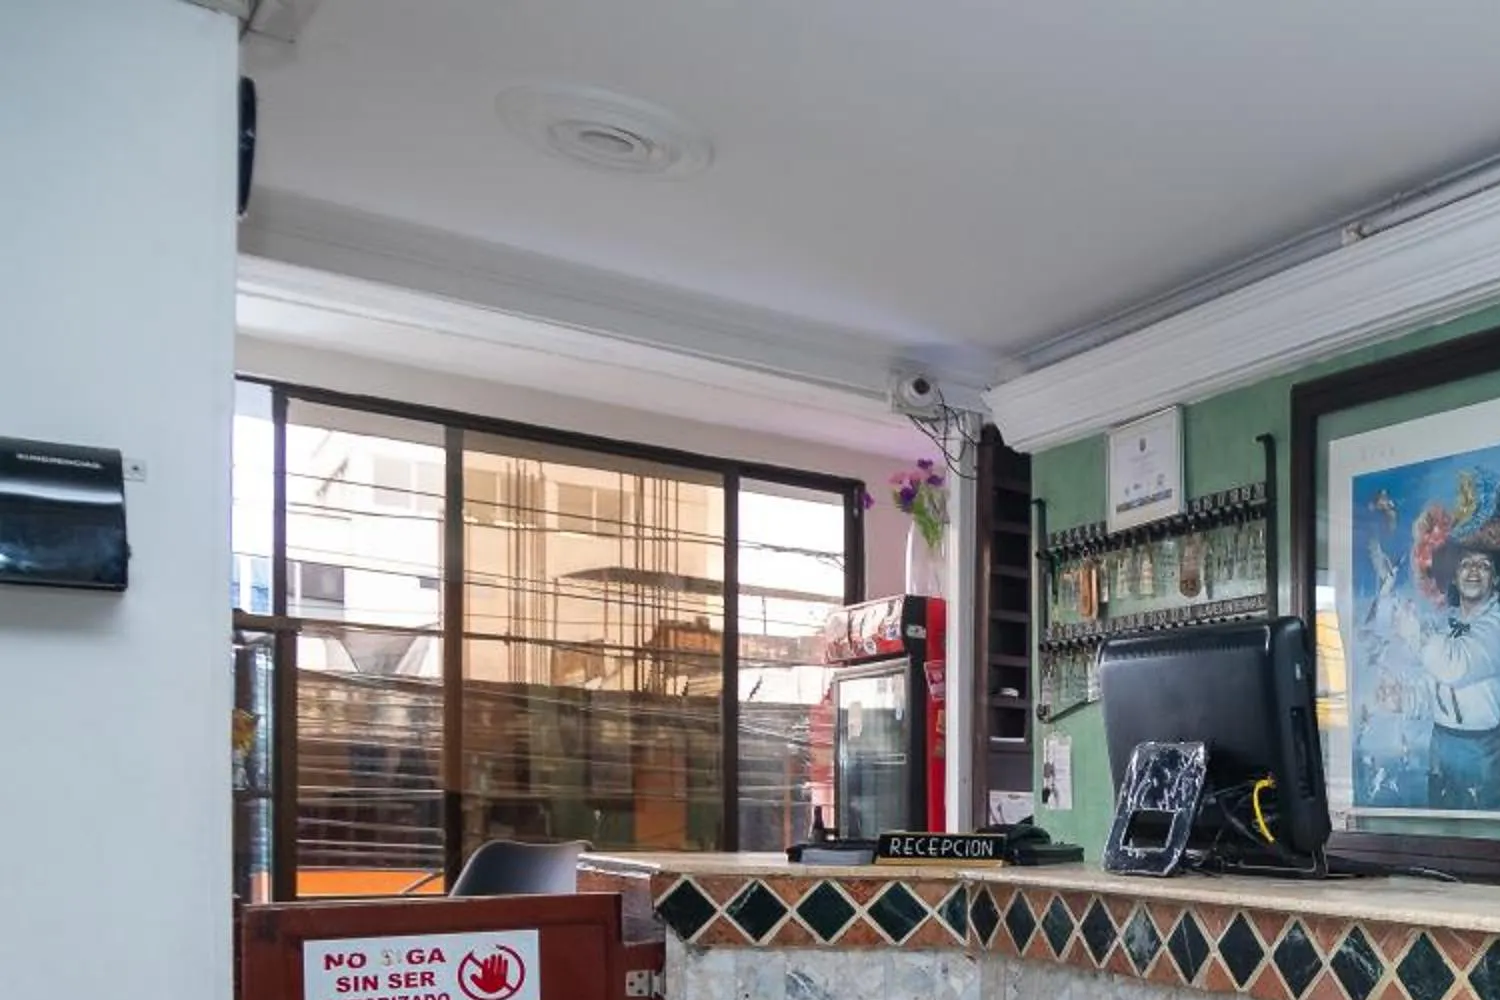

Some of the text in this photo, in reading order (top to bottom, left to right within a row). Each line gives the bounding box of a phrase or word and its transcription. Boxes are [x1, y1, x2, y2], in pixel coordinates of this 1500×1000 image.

[889, 836, 994, 858] RECEPCION
[323, 951, 368, 971] NO
[335, 971, 437, 994] SIN SER
